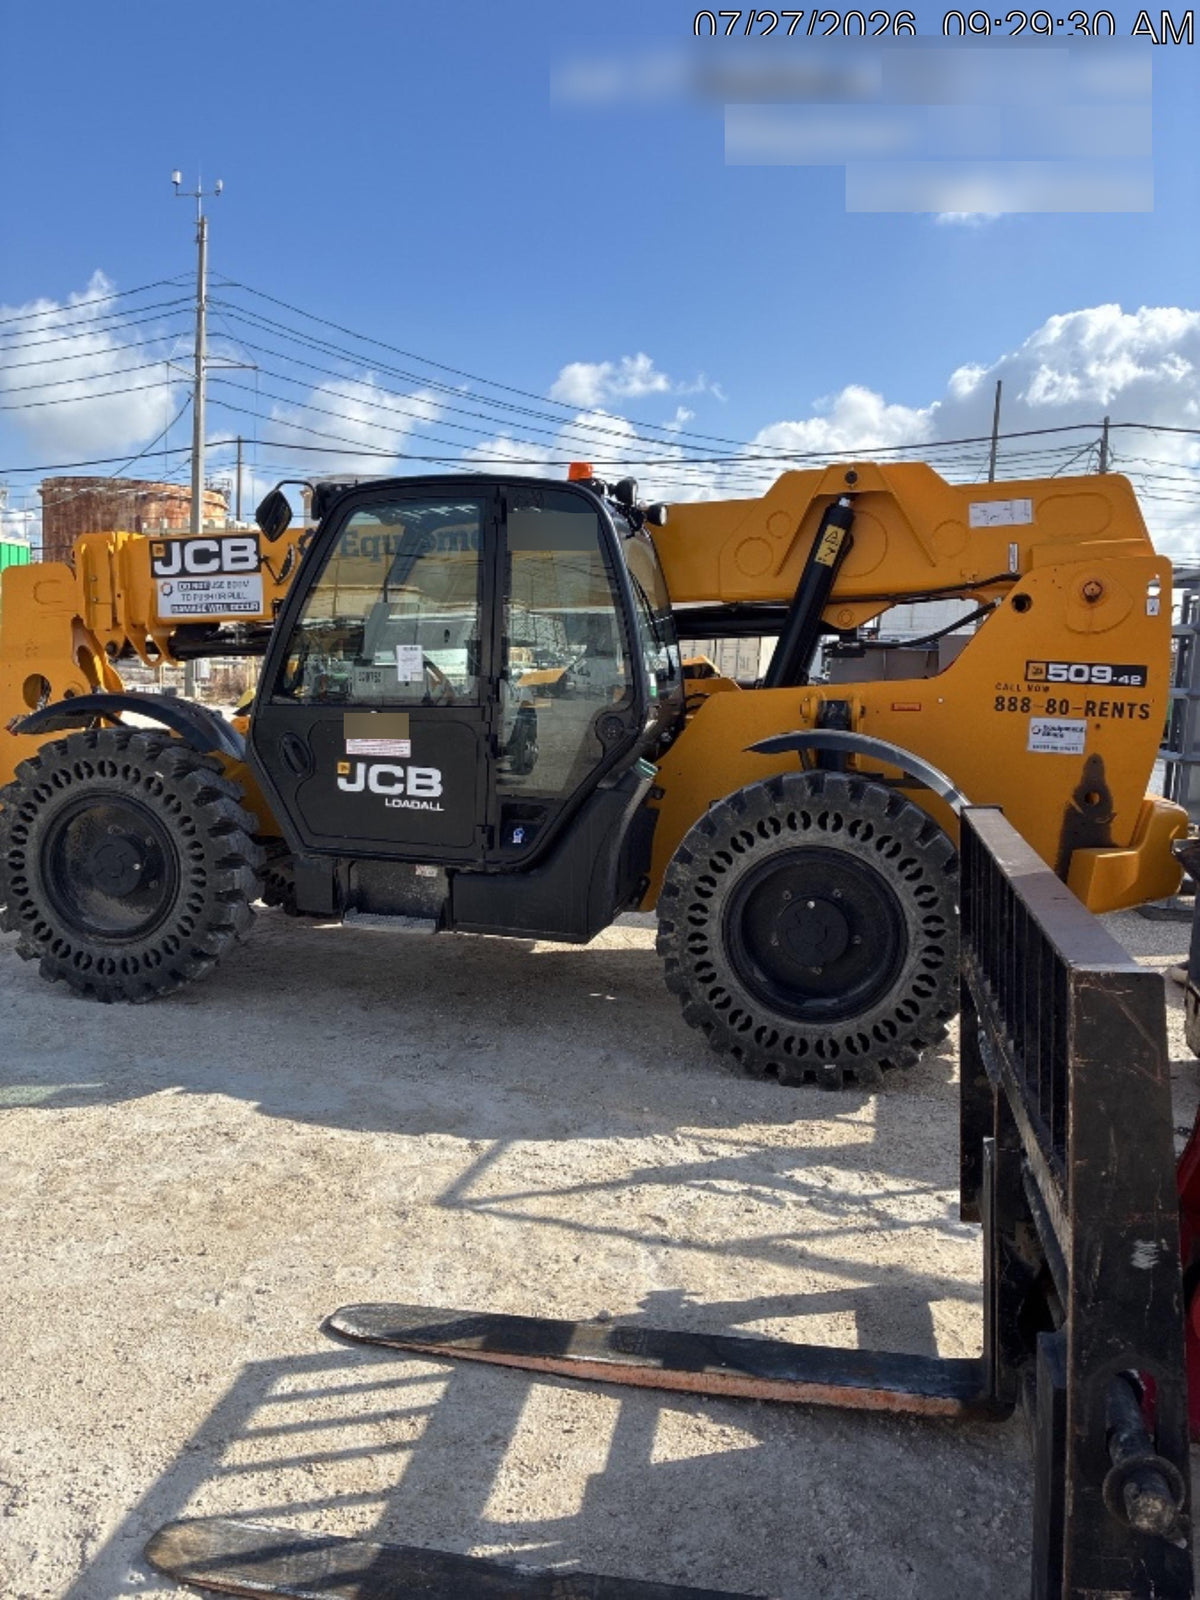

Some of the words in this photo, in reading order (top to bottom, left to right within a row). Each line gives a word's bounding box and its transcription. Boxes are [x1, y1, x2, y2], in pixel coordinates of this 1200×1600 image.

[154, 538, 258, 574] JCB
[337, 762, 443, 798] JCB
[384, 798, 444, 811] LOADALL
